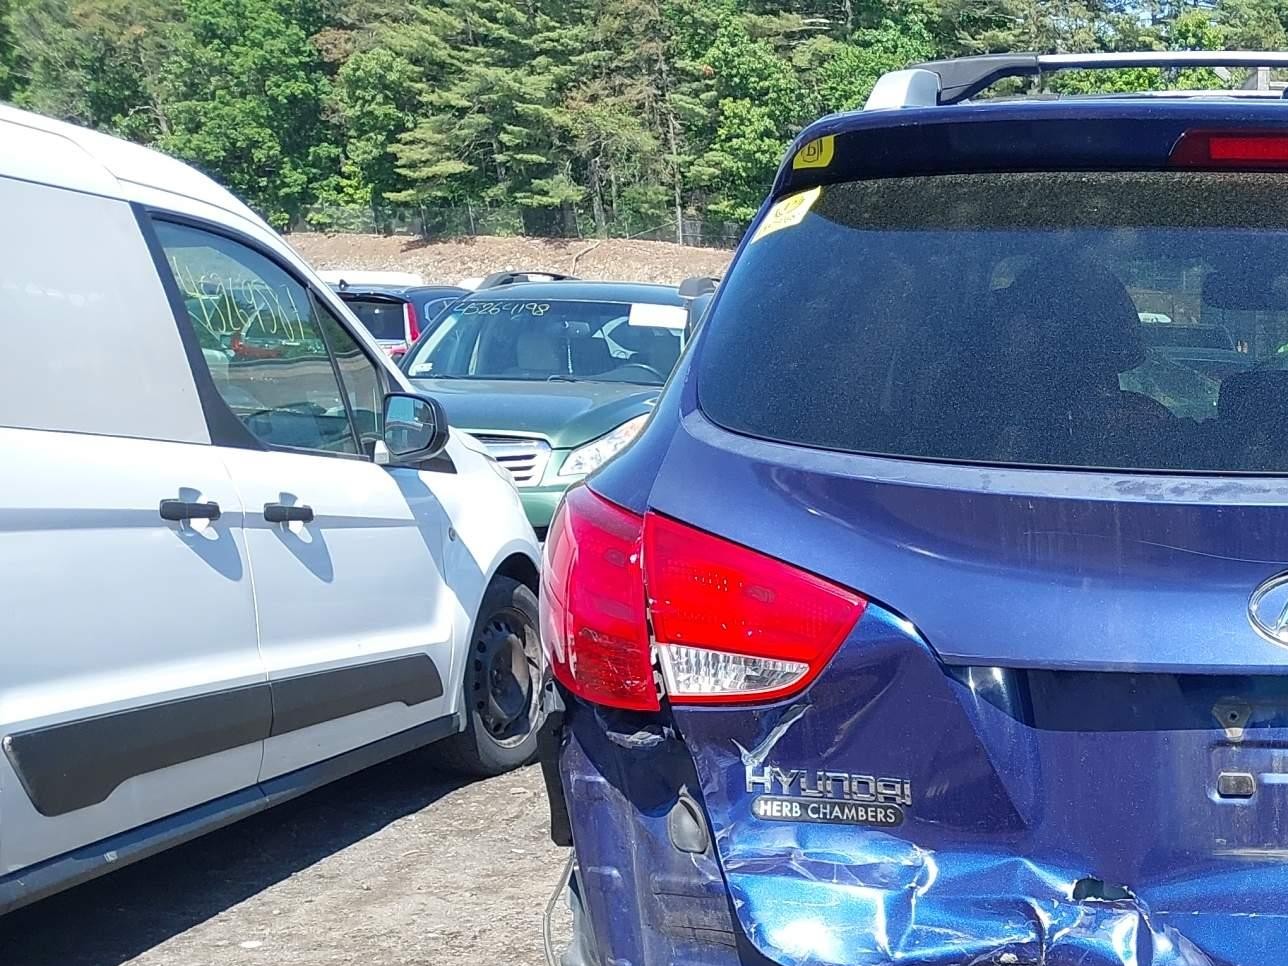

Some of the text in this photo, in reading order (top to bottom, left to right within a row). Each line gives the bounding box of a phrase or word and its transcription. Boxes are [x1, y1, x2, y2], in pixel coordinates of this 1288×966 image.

[745, 764, 913, 807] HYUNDAI
[758, 800, 896, 824] HERB CHAMBERS
